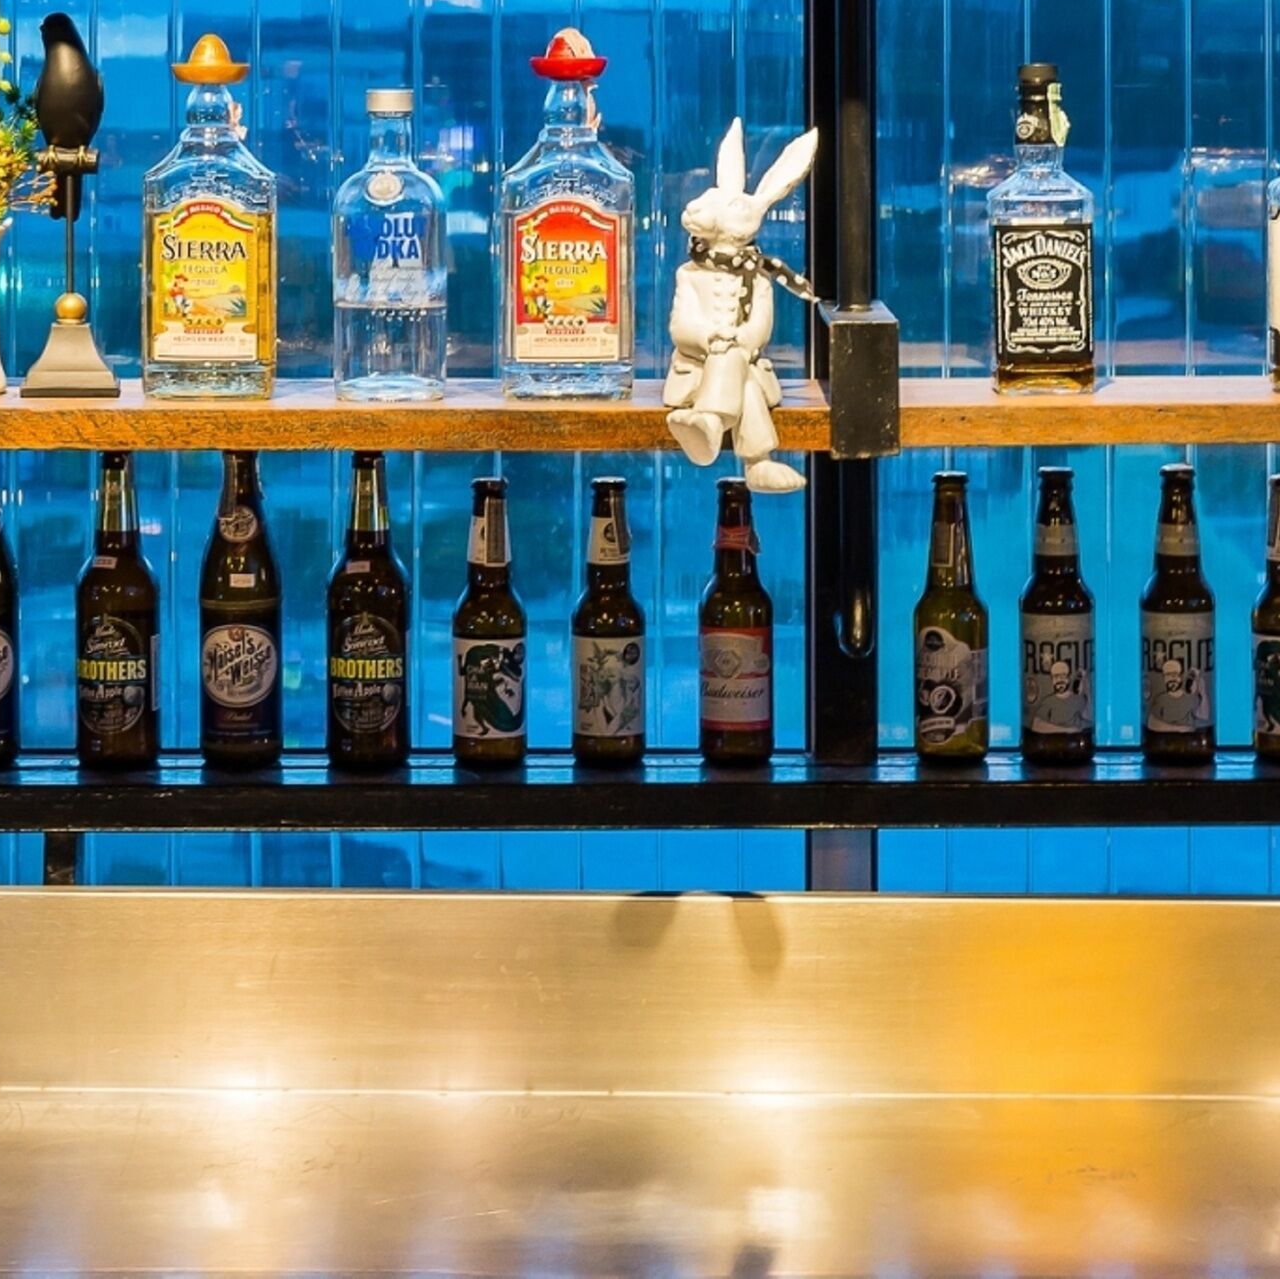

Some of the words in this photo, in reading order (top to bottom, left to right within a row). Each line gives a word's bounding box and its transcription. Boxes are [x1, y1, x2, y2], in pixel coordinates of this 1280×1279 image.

[162, 233, 247, 262] SIERRA
[520, 233, 608, 264] SIERRA
[1002, 238, 1035, 269] JACK
[1035, 233, 1087, 268] DANIEL'S
[183, 265, 228, 274] TEQUILA
[544, 266, 588, 275] TEQUILA
[1018, 306, 1073, 317] WHISKEY
[79, 659, 146, 681] BROTHERS
[330, 658, 404, 679] BROTHERS
